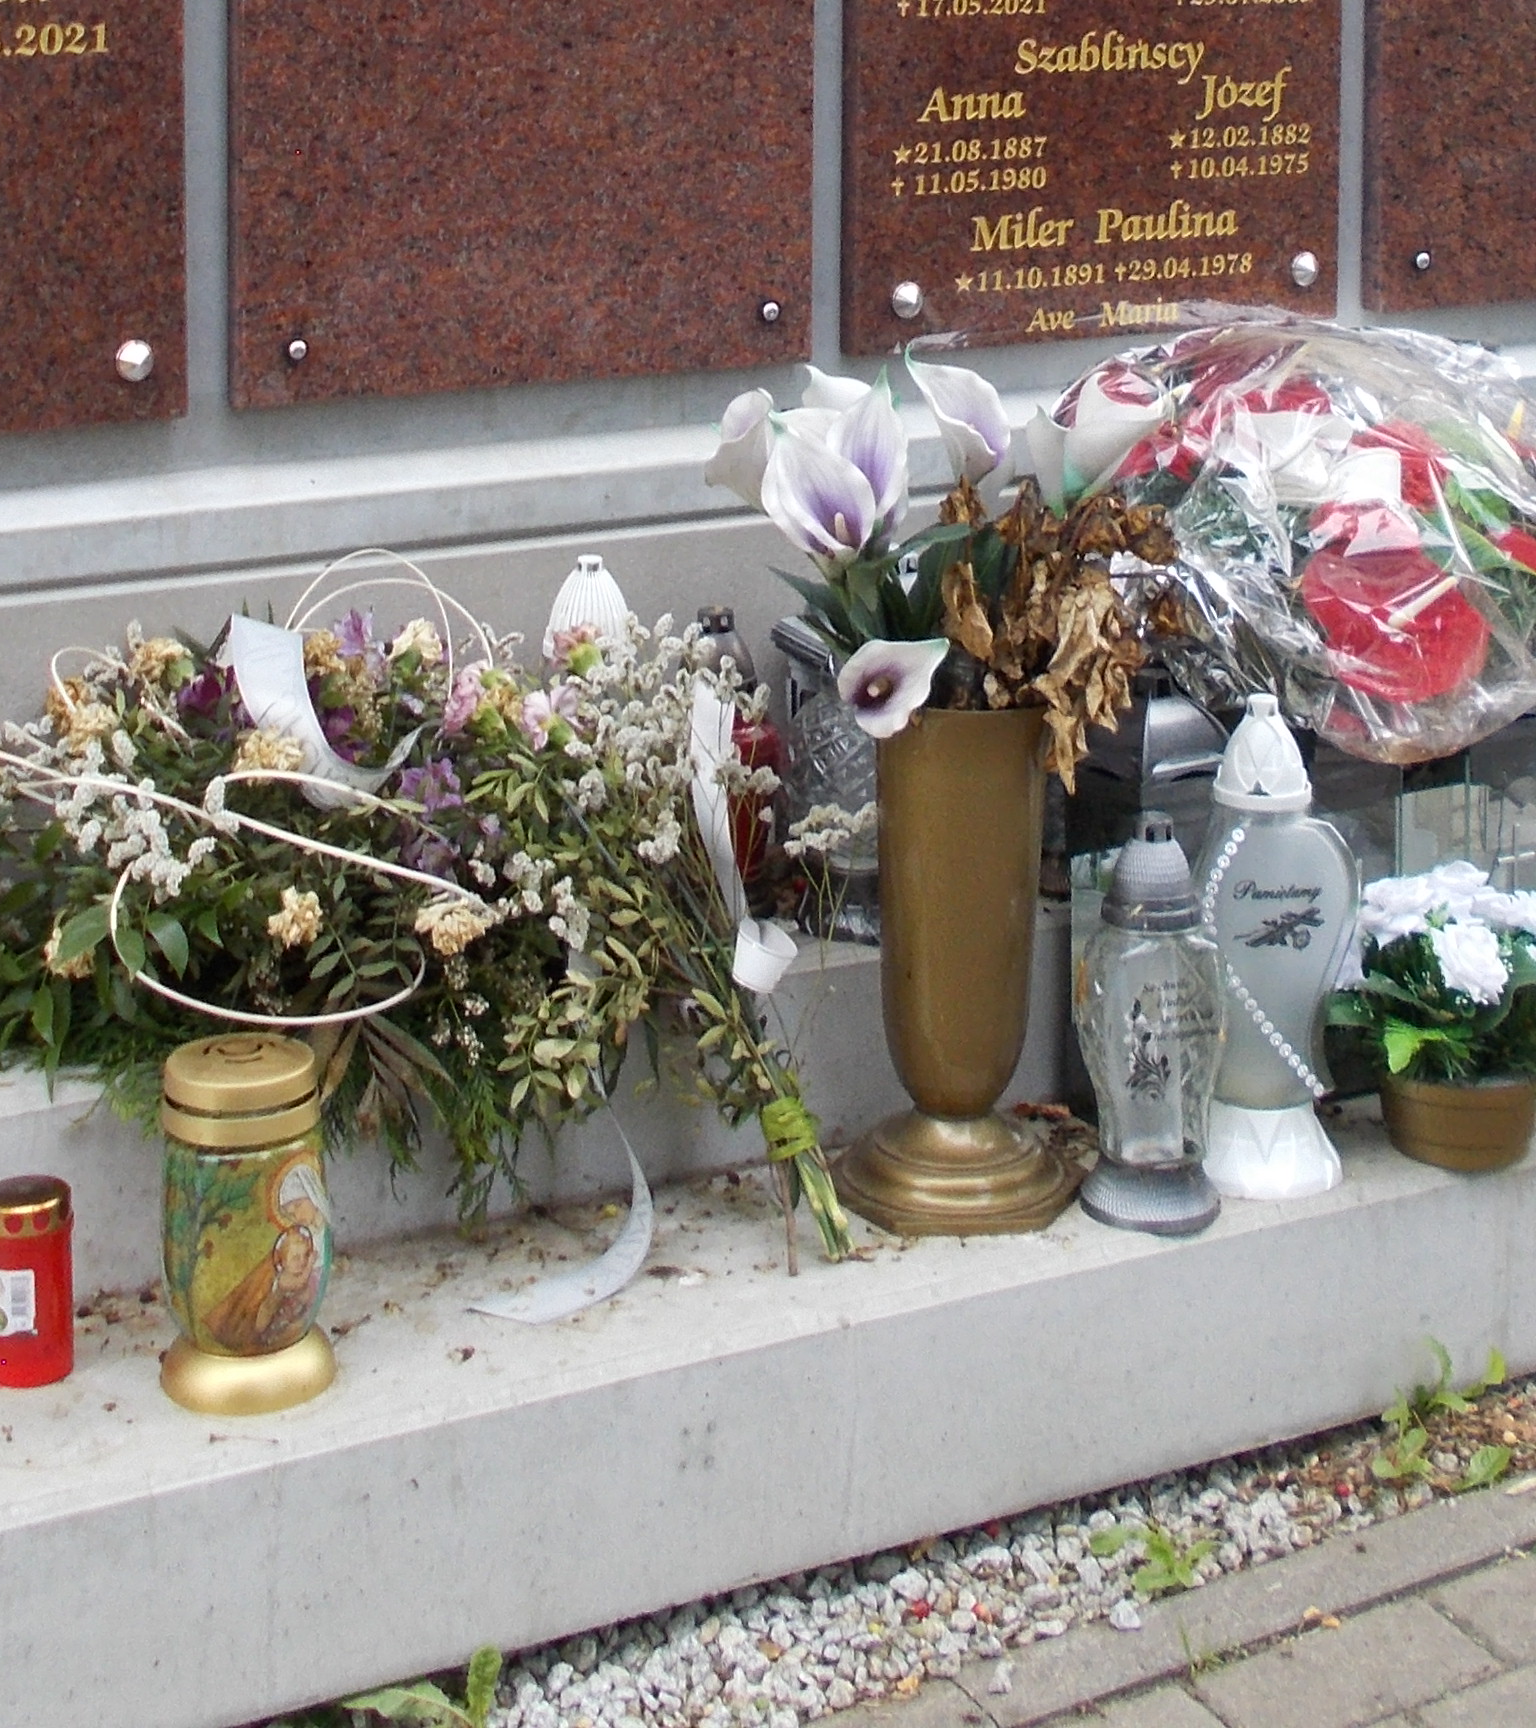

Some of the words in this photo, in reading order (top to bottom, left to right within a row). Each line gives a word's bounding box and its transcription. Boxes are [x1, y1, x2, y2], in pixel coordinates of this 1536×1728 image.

[1014, 30, 1204, 85] Szablińscy
[919, 87, 1025, 122] Anna
[1196, 67, 1292, 121] Józef
[971, 207, 1074, 251] Miler
[1095, 200, 1238, 244] Paulina
[1025, 307, 1075, 333] Ave
[1099, 297, 1179, 328] Maria
